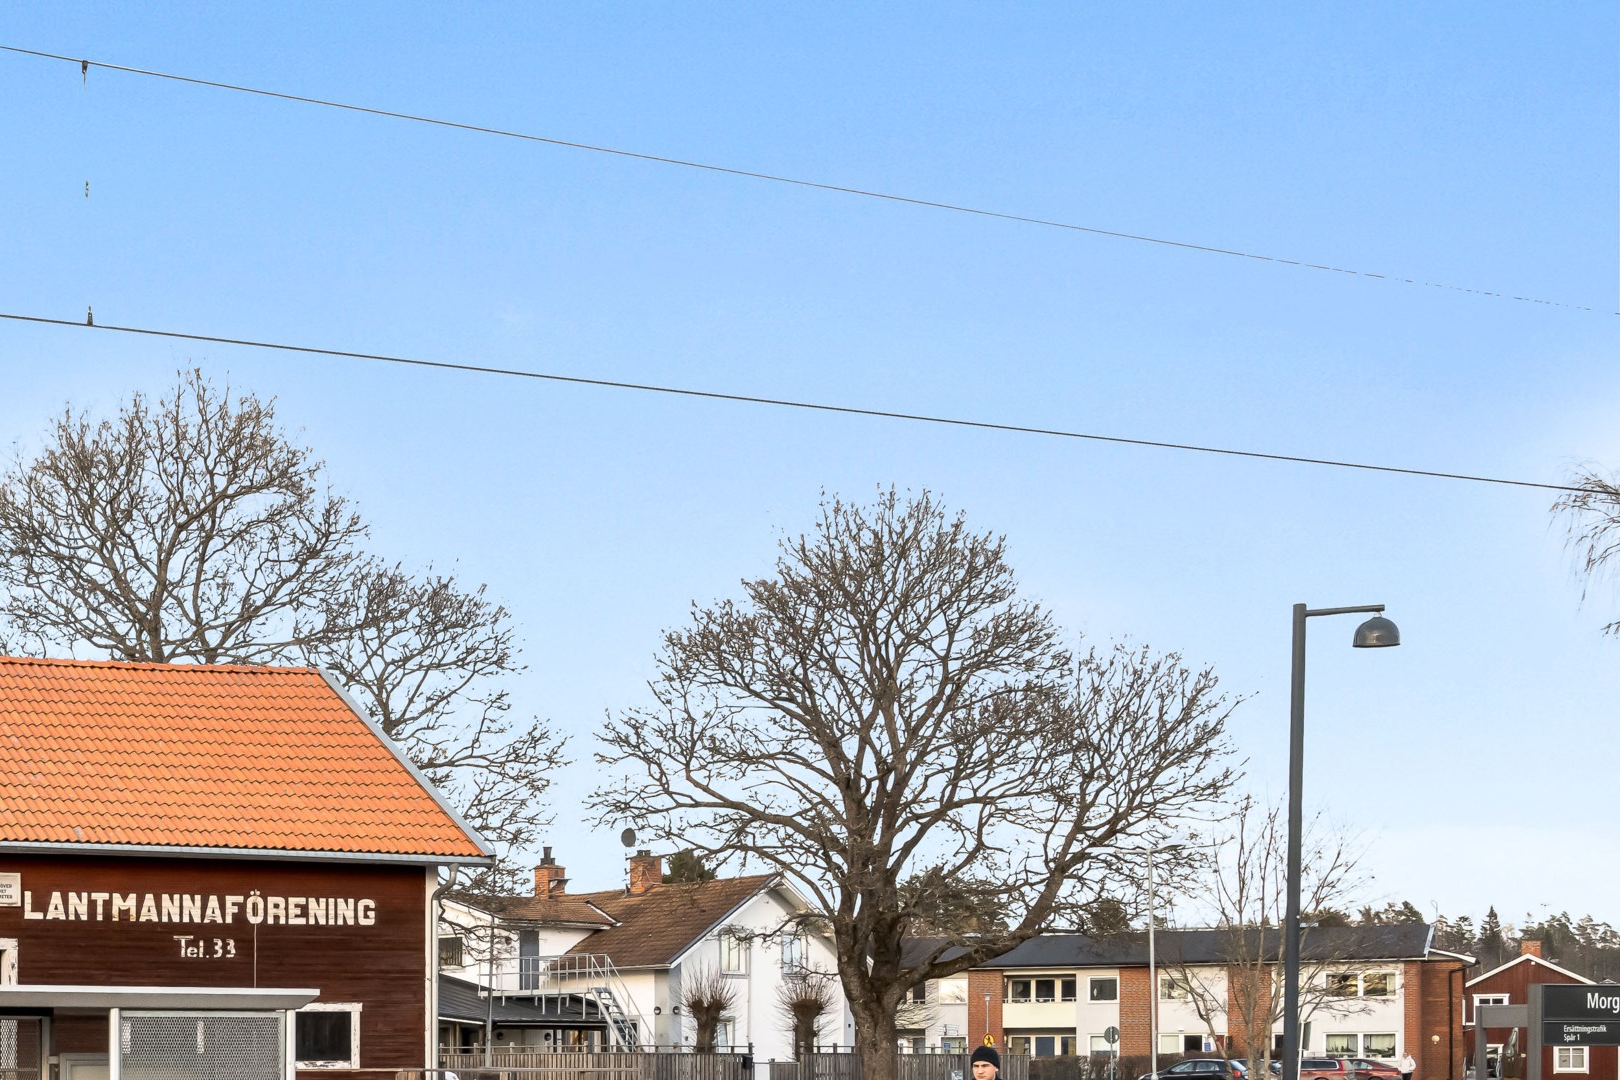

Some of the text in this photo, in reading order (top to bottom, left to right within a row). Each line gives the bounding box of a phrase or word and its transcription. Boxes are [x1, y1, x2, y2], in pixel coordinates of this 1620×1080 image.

[23, 889, 376, 926] LANTMANNAFÖRENING
[173, 935, 237, 958] Tel. 33
[1586, 992, 1620, 1013] Morg
[1563, 1025, 1607, 1034] Ersättningstrafik
[1563, 1033, 1576, 1043] Spår
